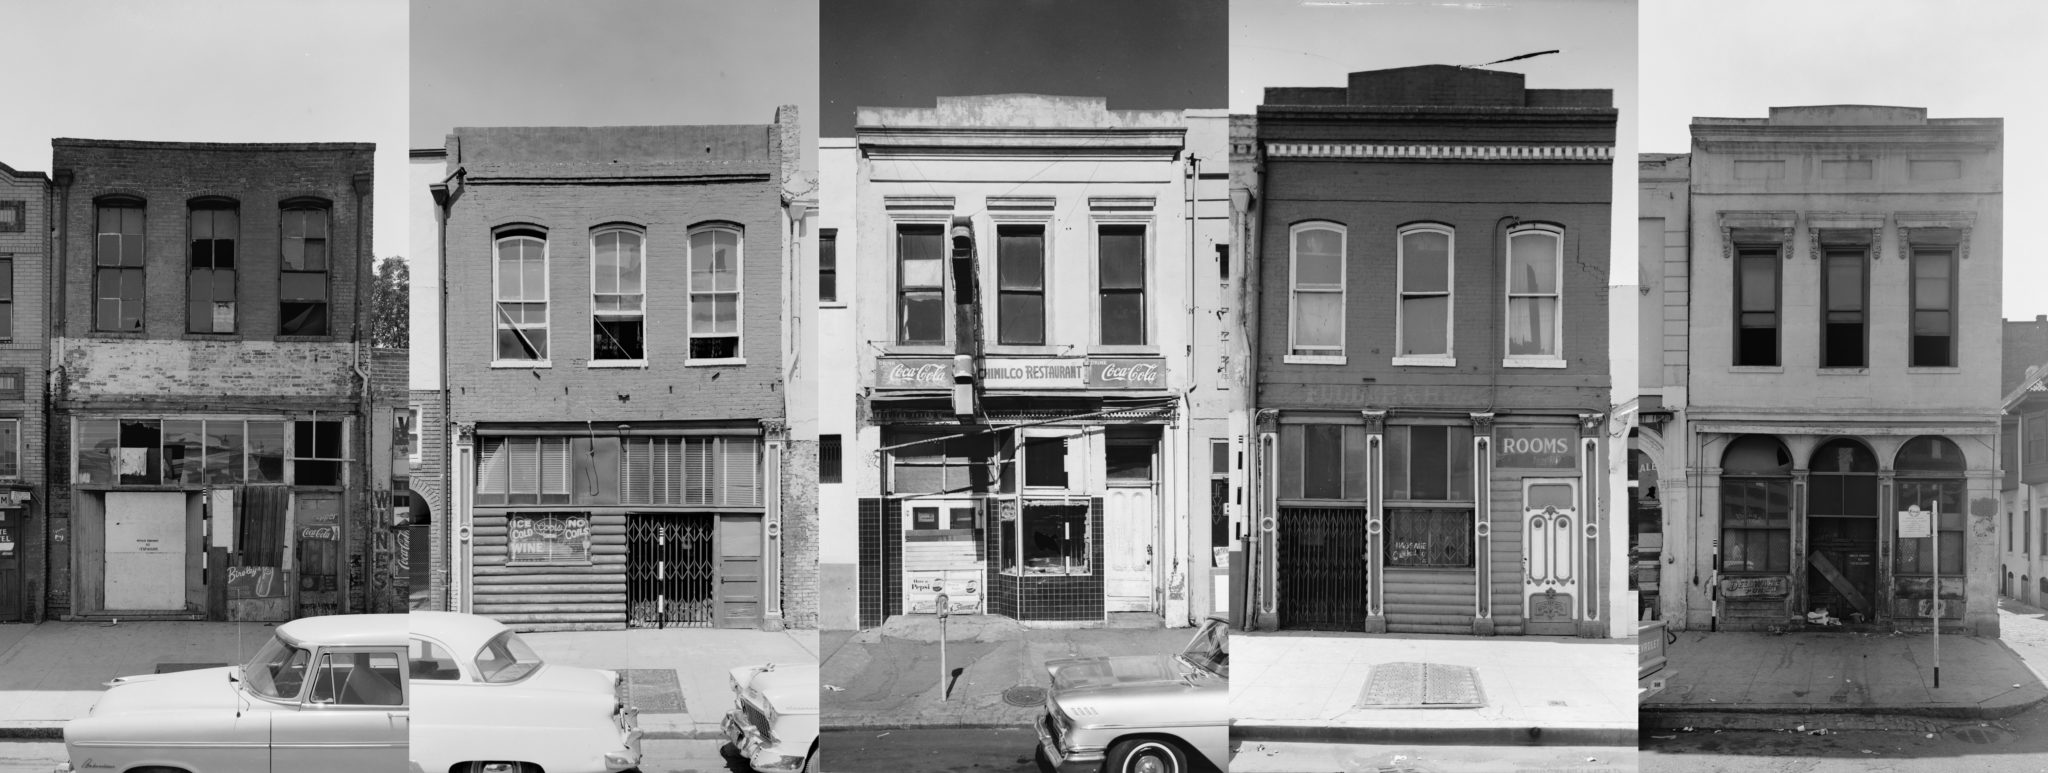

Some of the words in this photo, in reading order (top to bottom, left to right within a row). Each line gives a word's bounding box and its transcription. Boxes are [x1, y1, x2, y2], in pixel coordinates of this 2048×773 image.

[1025, 365, 1082, 379] RESTAURANT
[1503, 437, 1569, 455] ROOMS
[513, 520, 531, 528] ICE
[512, 529, 533, 539] COLD
[565, 528, 590, 539] COILS
[510, 543, 543, 553] WINE
